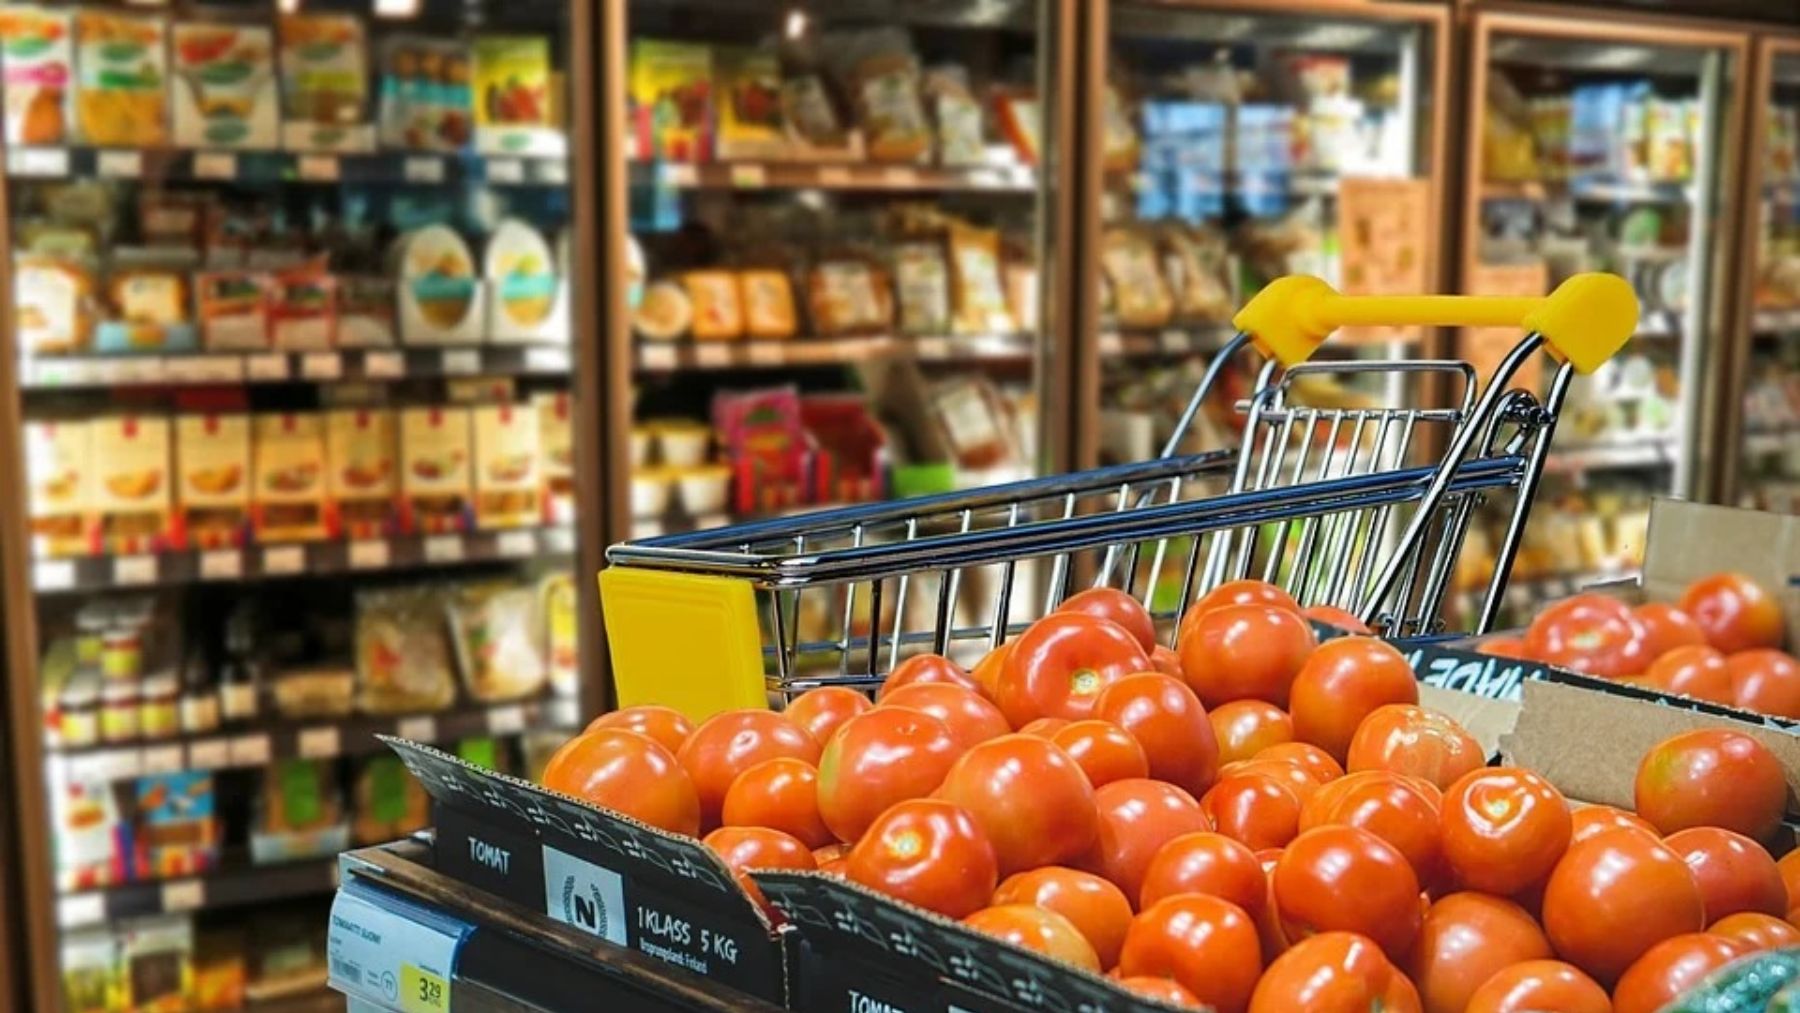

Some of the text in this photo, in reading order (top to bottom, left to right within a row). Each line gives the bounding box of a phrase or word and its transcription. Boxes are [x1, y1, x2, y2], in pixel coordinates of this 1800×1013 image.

[467, 836, 511, 875] TOMAT
[574, 894, 596, 929] N
[700, 928, 710, 953] 5
[714, 933, 738, 965] KG
